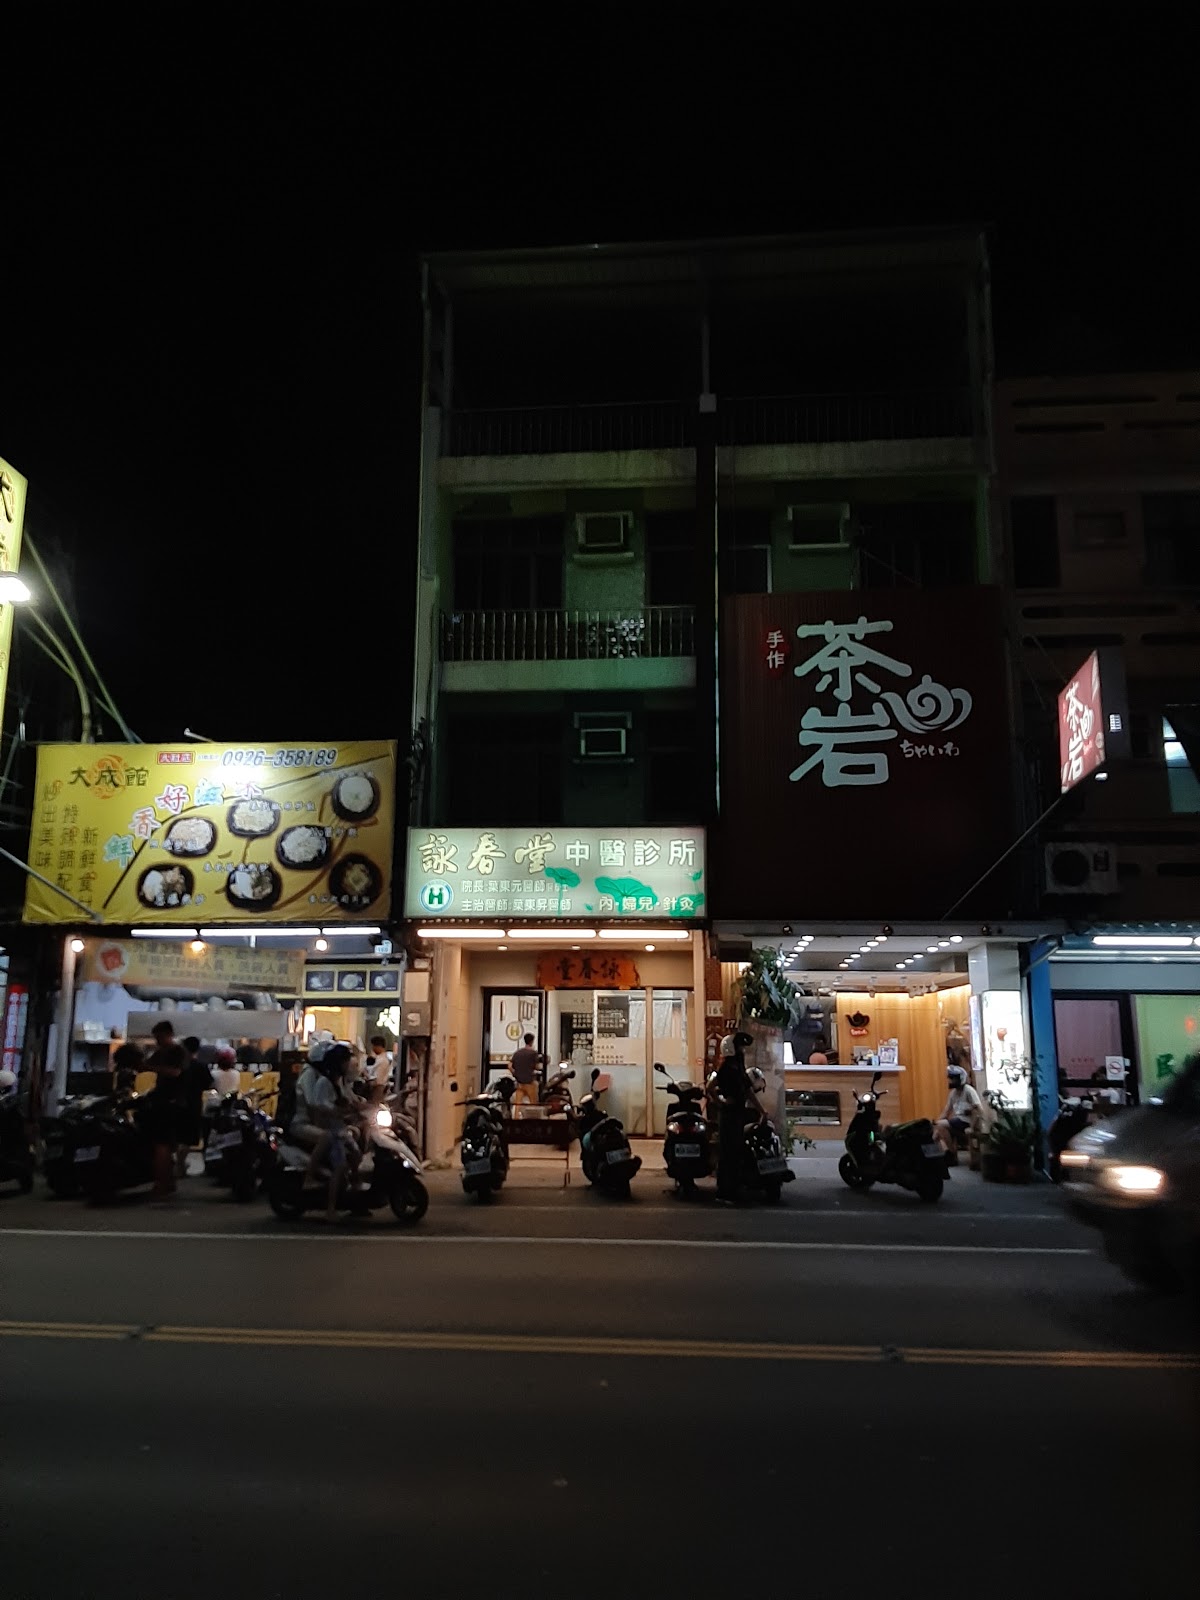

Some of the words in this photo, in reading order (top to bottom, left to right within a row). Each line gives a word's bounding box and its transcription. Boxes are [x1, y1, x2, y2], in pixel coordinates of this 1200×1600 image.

[766, 629, 785, 669] 手作
[788, 615, 912, 787] 茶岩
[221, 750, 338, 767] 0926-358189
[900, 738, 961, 760] ちゃいわ
[68, 765, 149, 788] 大成館
